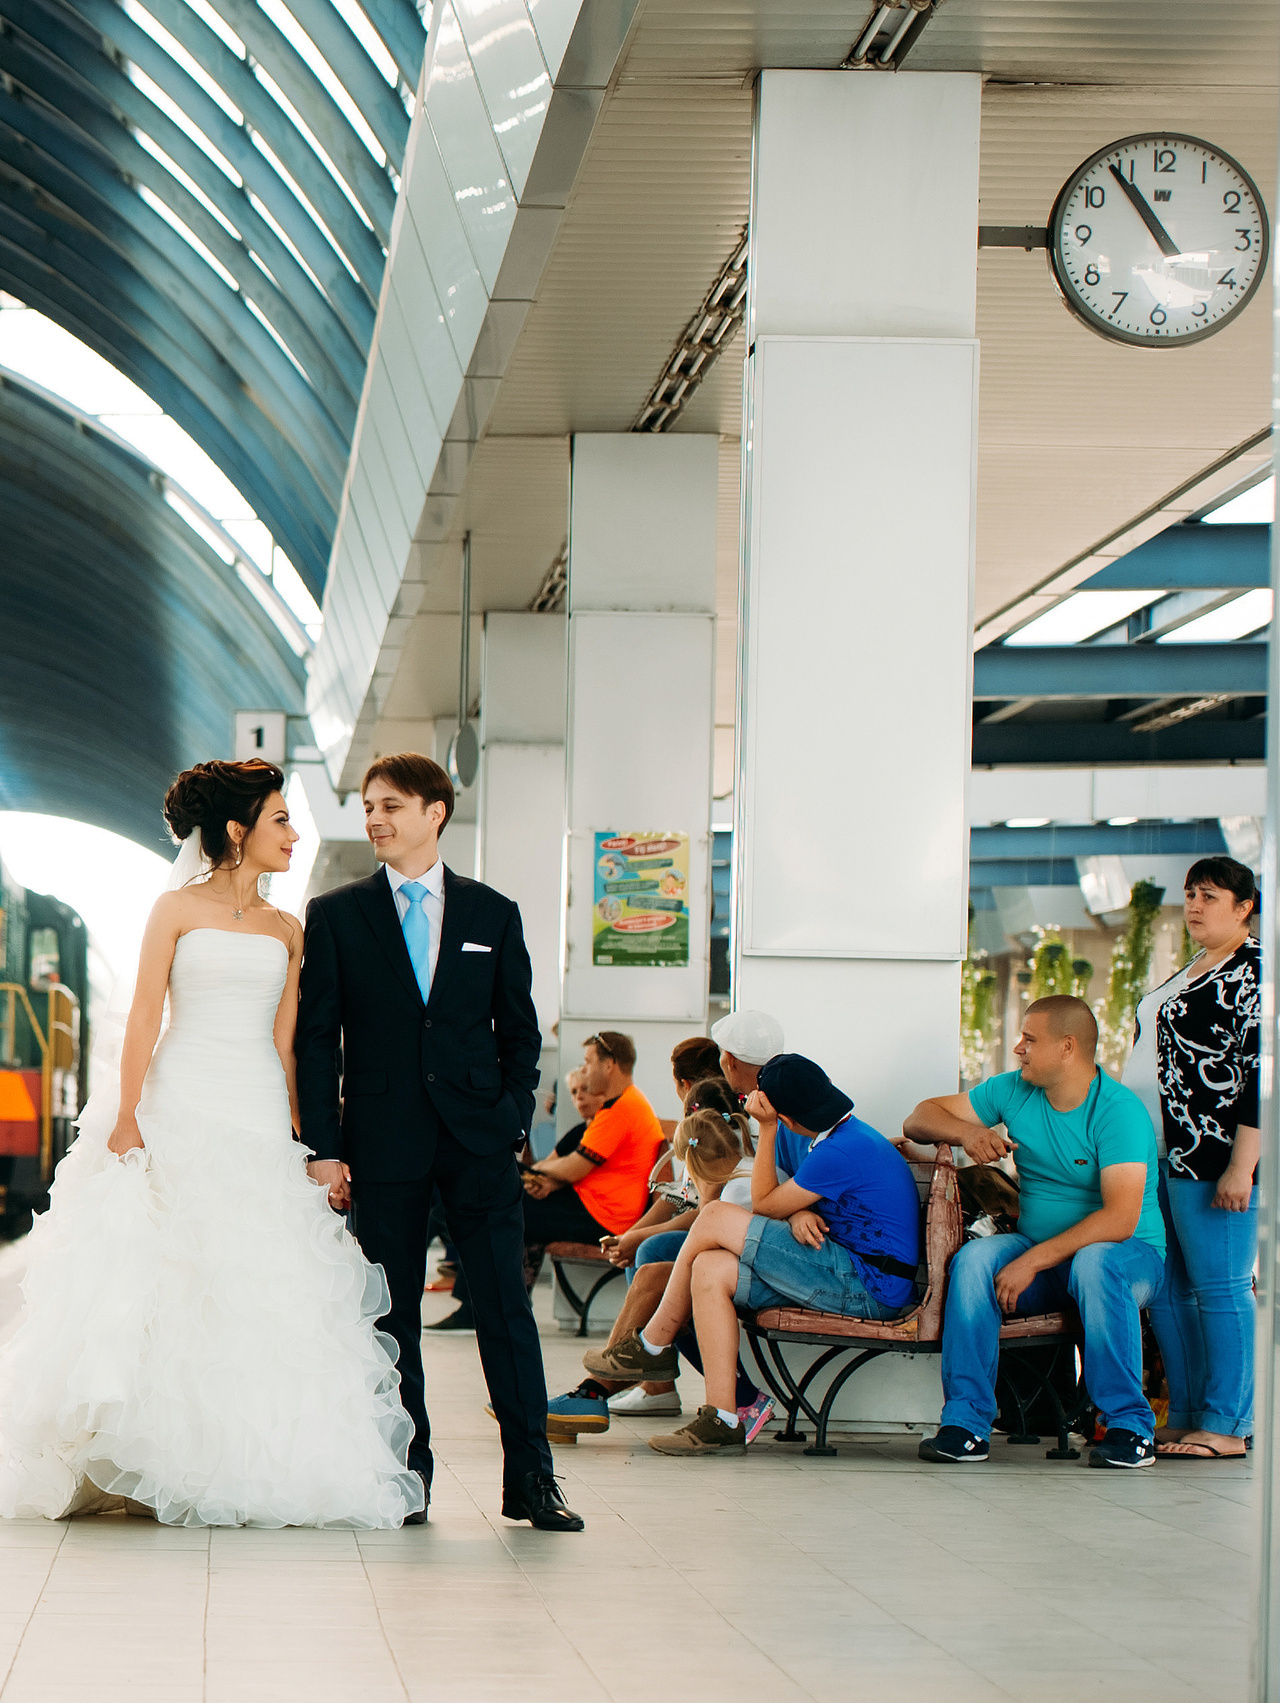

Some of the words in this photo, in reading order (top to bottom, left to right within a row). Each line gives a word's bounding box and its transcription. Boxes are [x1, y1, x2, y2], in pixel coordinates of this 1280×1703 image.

[1153, 149, 1176, 173] 12
[1201, 161, 1207, 184] 1
[1084, 186, 1105, 209] 10
[1223, 190, 1241, 214] 2
[1076, 224, 1092, 247] 9
[1234, 228, 1251, 252] 3
[1084, 263, 1100, 286] 8
[1216, 267, 1236, 290] 4
[1111, 291, 1129, 314] 7
[1149, 303, 1167, 325] 6
[1191, 295, 1207, 317] 5
[250, 727, 264, 748] 1
